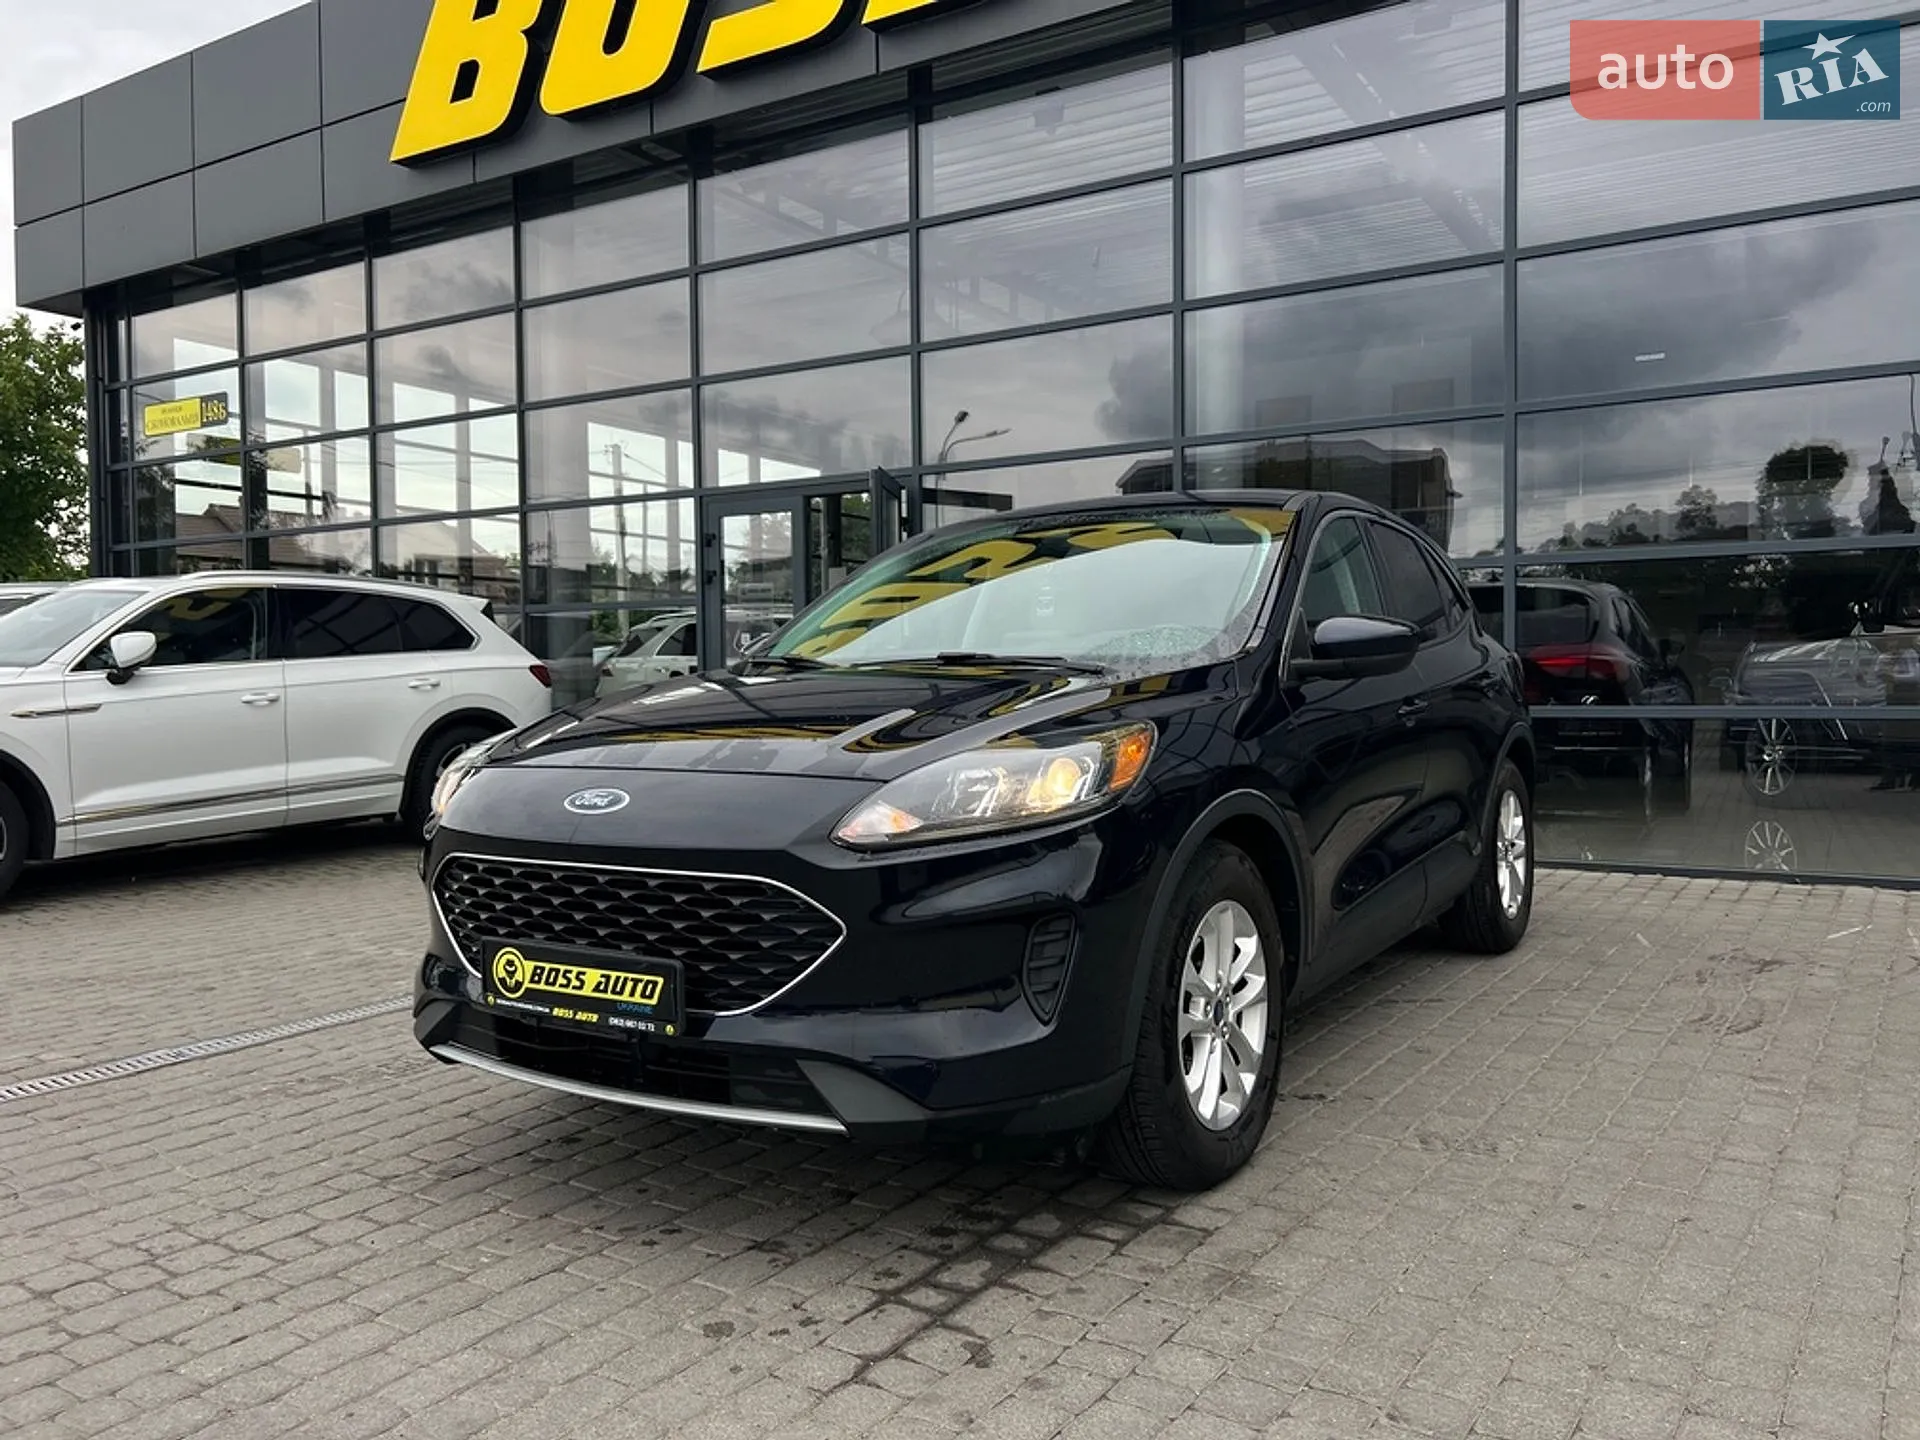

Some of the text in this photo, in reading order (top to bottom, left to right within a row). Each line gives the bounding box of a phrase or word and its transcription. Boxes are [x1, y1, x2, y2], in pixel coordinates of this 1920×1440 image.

[389, 0, 945, 162] BO
[528, 964, 660, 1000] BOSS AUTO
